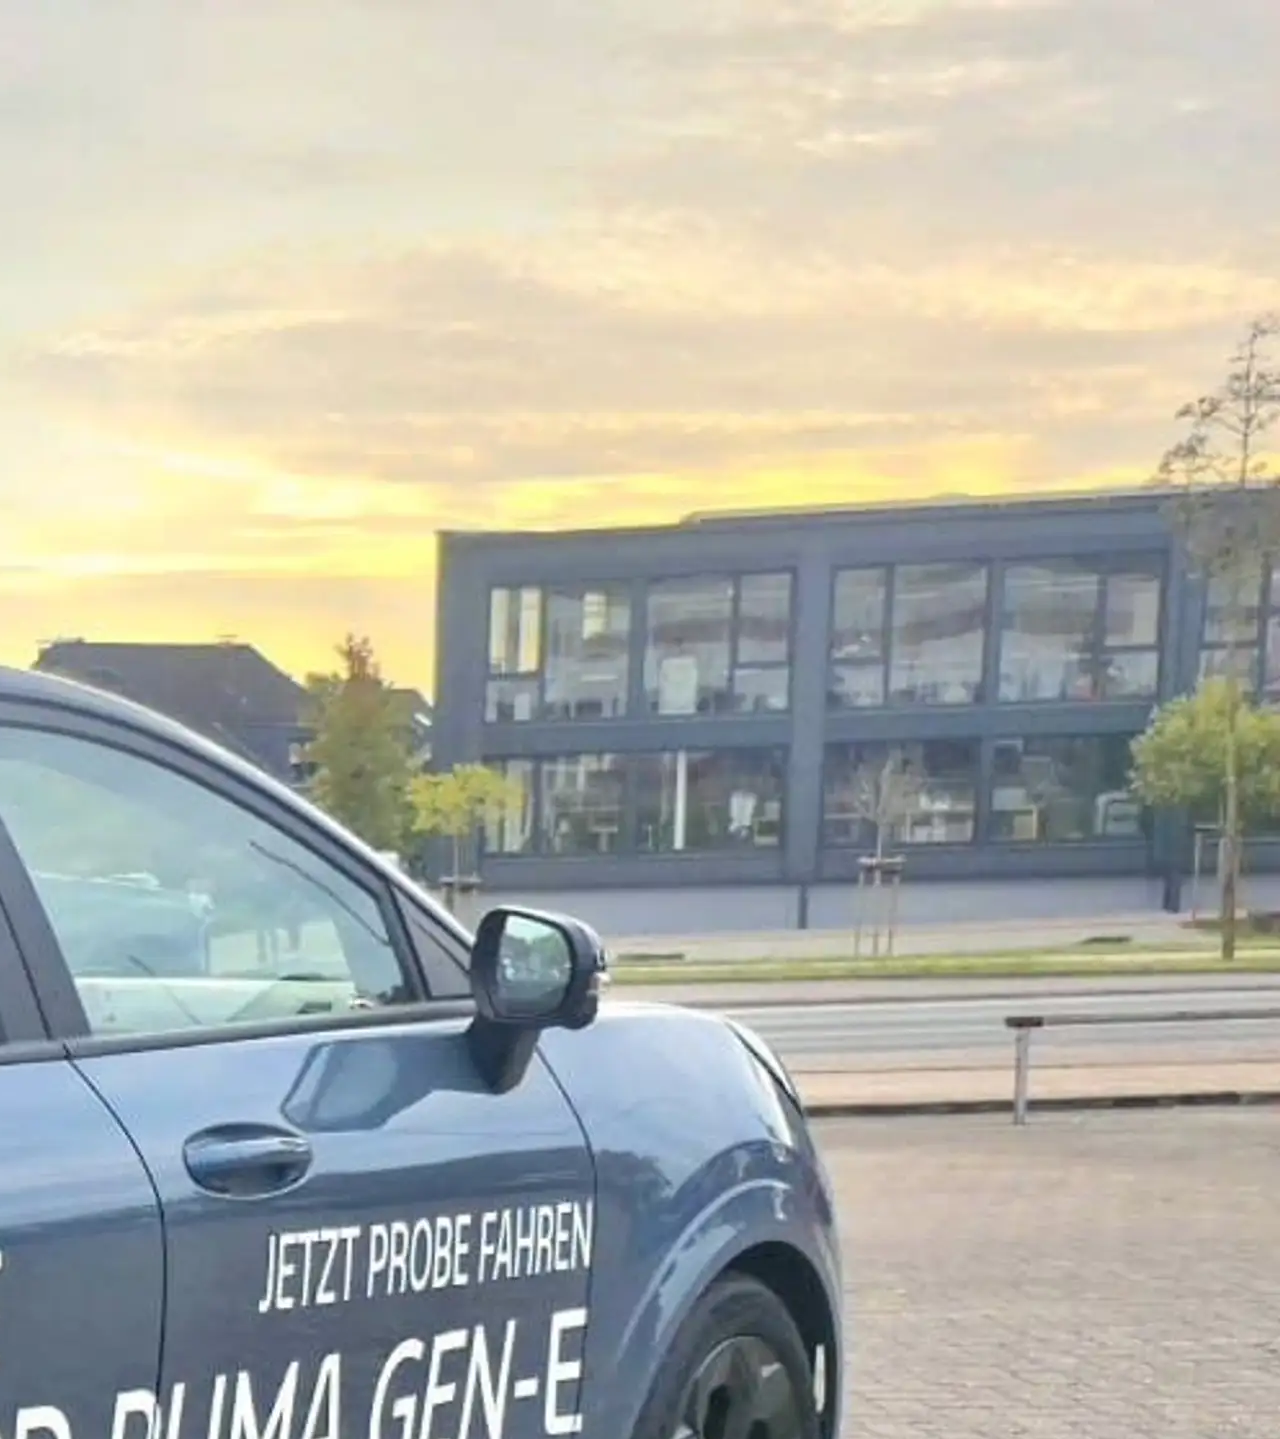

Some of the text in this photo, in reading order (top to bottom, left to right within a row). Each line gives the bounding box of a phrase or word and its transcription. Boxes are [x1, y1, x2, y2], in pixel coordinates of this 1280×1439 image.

[258, 1200, 594, 1314] JETZT PROBE FAHREN
